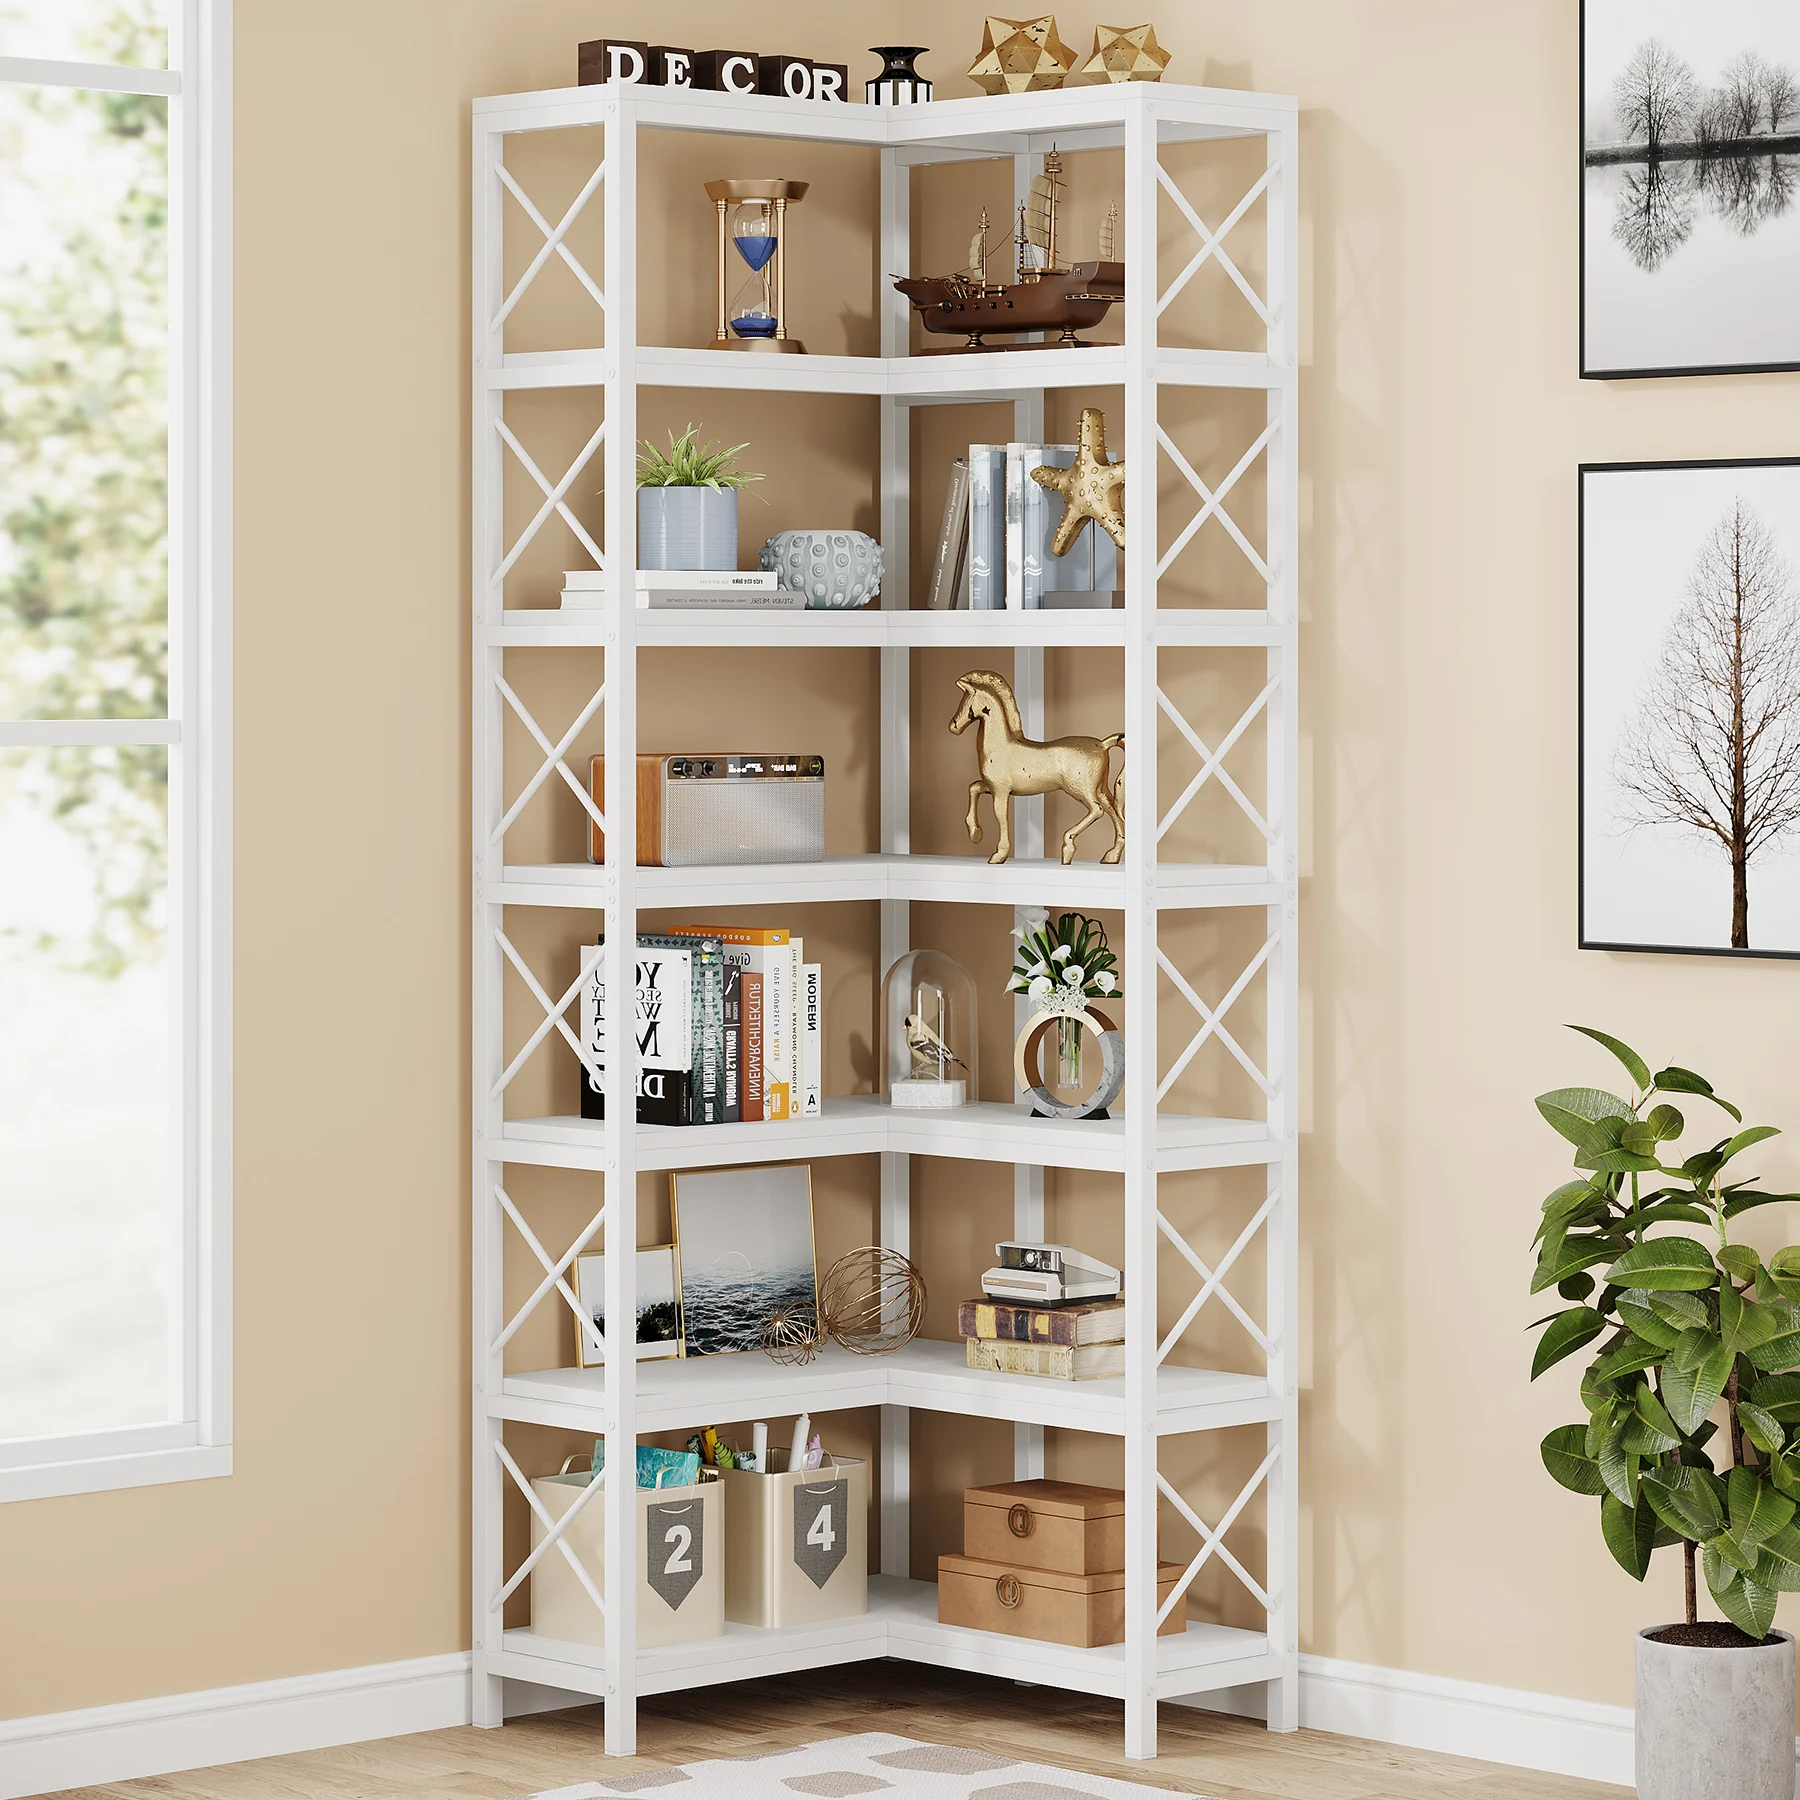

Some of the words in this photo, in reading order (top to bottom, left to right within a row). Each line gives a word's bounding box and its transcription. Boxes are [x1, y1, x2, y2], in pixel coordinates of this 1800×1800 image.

[606, 45, 844, 103] DECOR
[663, 1524, 692, 1575] 2
[806, 1503, 836, 1552] 4
